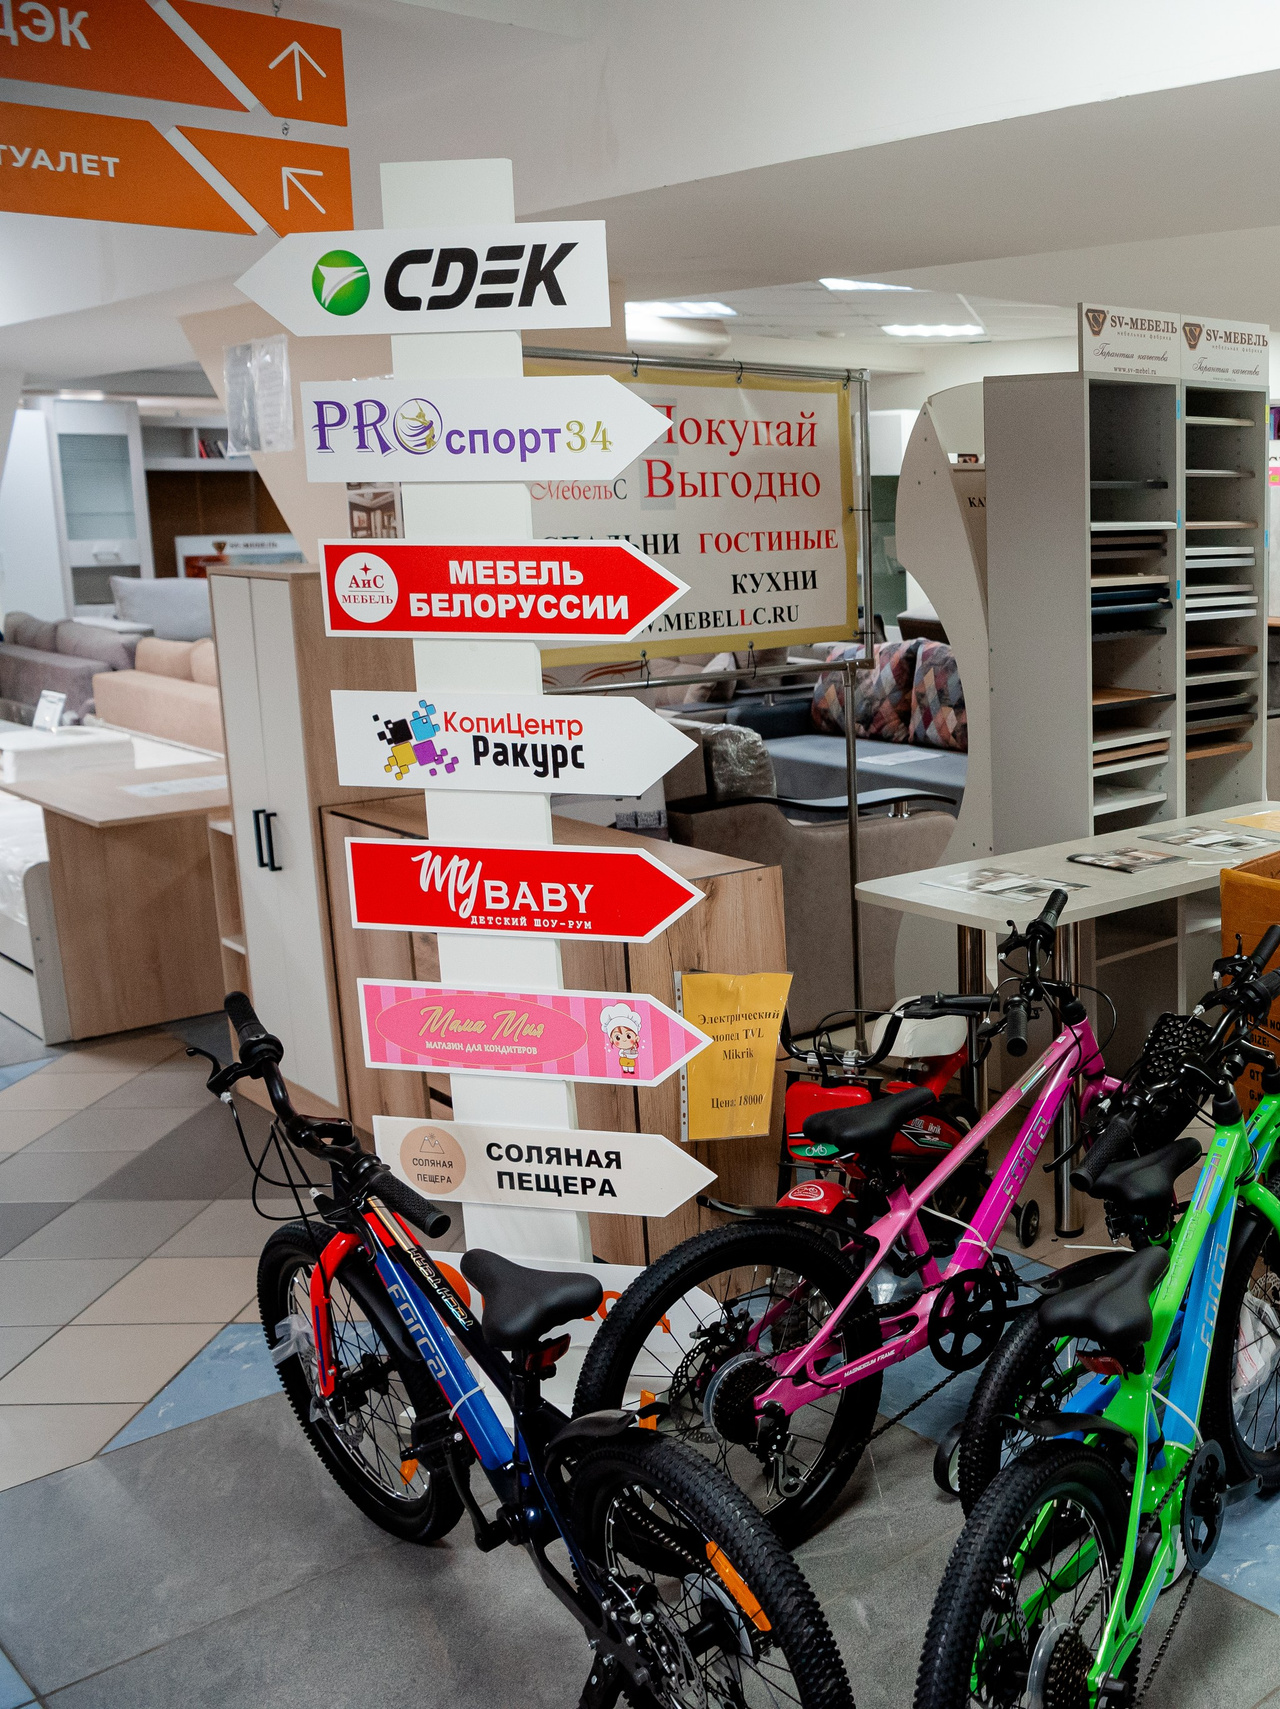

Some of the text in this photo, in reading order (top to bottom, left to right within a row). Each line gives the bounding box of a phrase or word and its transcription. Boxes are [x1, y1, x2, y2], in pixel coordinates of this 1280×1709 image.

[384, 242, 579, 312] CDEK
[1093, 342, 1169, 362] Гарантия качества
[642, 458, 821, 504] Выгодно
[698, 529, 839, 555] ГОСТИНЫЕ
[348, 574, 385, 589] АиС
[448, 560, 584, 586] МЕБЕЛЬ
[731, 569, 818, 595] КУХНИ
[341, 593, 394, 605] МЕБЕЛЬ
[409, 593, 630, 620] БЕЛОРУССИИ
[442, 711, 584, 741] КопиЦентр
[472, 735, 586, 779] Ракурс
[483, 879, 595, 914] BABY
[470, 915, 593, 930] ДЕТСКИЙ ШОУ-РУМ
[418, 1006, 546, 1042] Мама Мия
[698, 1009, 780, 1025] Электрический
[425, 1040, 538, 1055] МАГАЗИН ДЛЯ КОНДИТЕРОВ
[711, 1027, 765, 1044] мопед TVL
[722, 1047, 755, 1061] Mikrik
[739, 1093, 764, 1107] 18000
[412, 1157, 454, 1169] СОЛЯНАЯ
[485, 1141, 622, 1170] СОЛЯНАЯ
[416, 1172, 453, 1185] ПЕЩЕРА
[497, 1169, 618, 1199] ПЕЩЕРА
